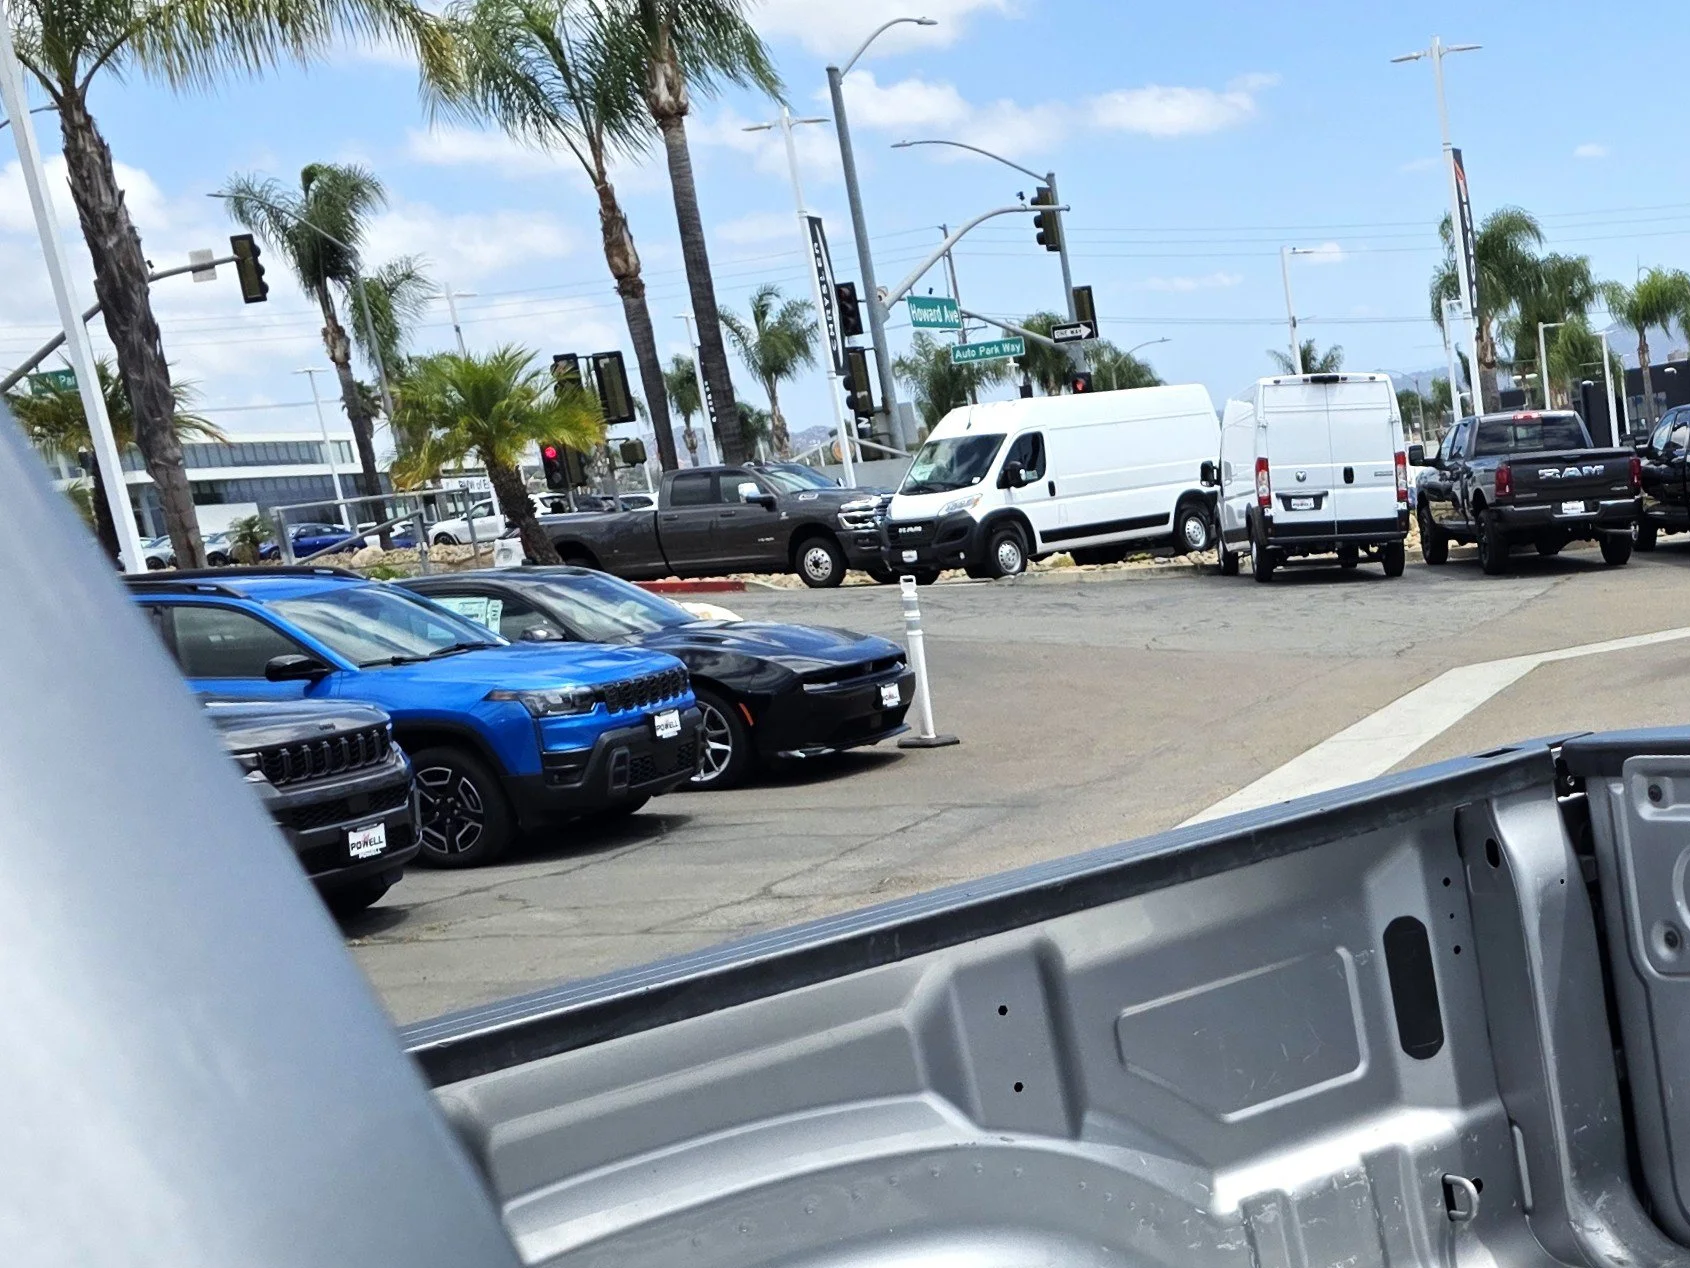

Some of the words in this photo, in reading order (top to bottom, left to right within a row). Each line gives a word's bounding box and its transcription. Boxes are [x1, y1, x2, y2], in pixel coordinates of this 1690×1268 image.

[910, 302, 943, 322] Howard
[943, 304, 960, 323] Ave
[955, 347, 976, 359] Auto
[979, 344, 1000, 356] Park
[1002, 342, 1021, 353] Way
[1538, 464, 1605, 480] RAM
[656, 720, 679, 731] POWELL
[350, 835, 384, 851] POWELL
